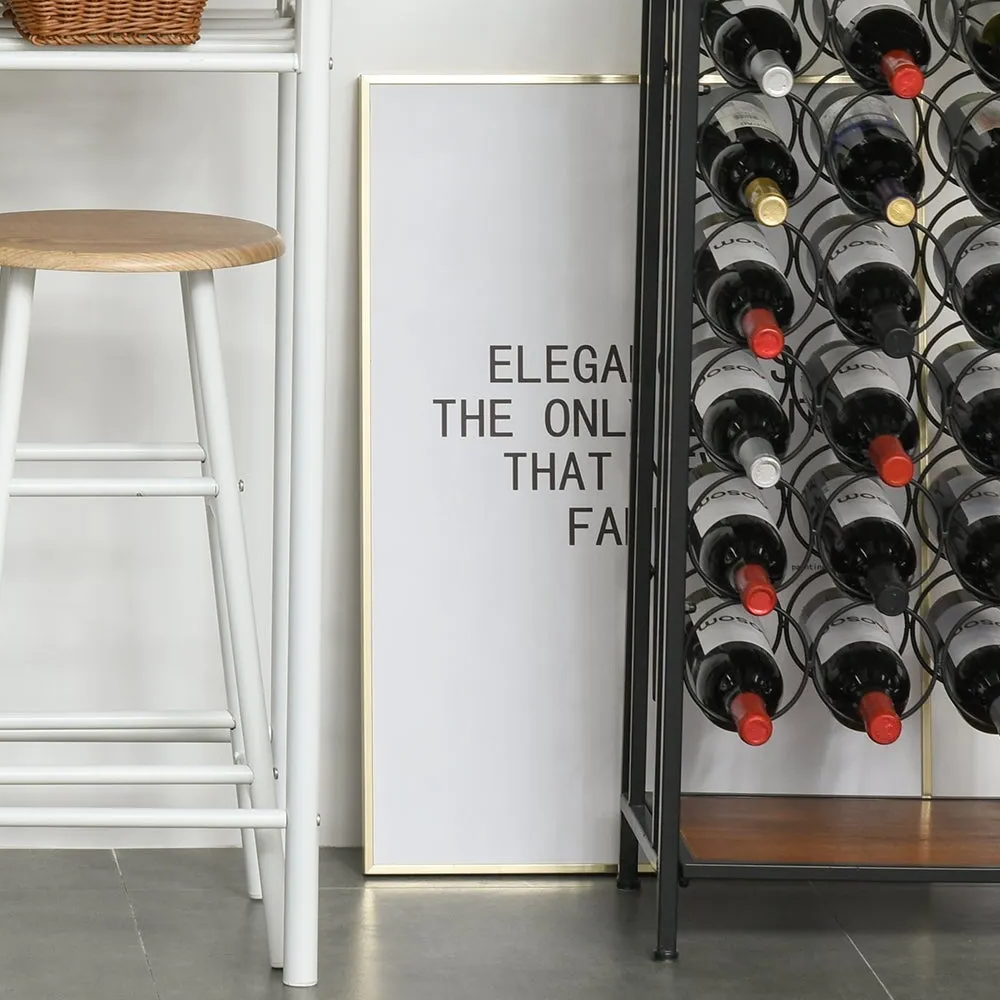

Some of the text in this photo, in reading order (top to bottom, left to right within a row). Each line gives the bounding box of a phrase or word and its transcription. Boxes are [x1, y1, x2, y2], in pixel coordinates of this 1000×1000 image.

[489, 345, 635, 384] ELEGA
[432, 398, 635, 437] THE ONL
[503, 452, 613, 491] THAT
[568, 507, 629, 546] FA
